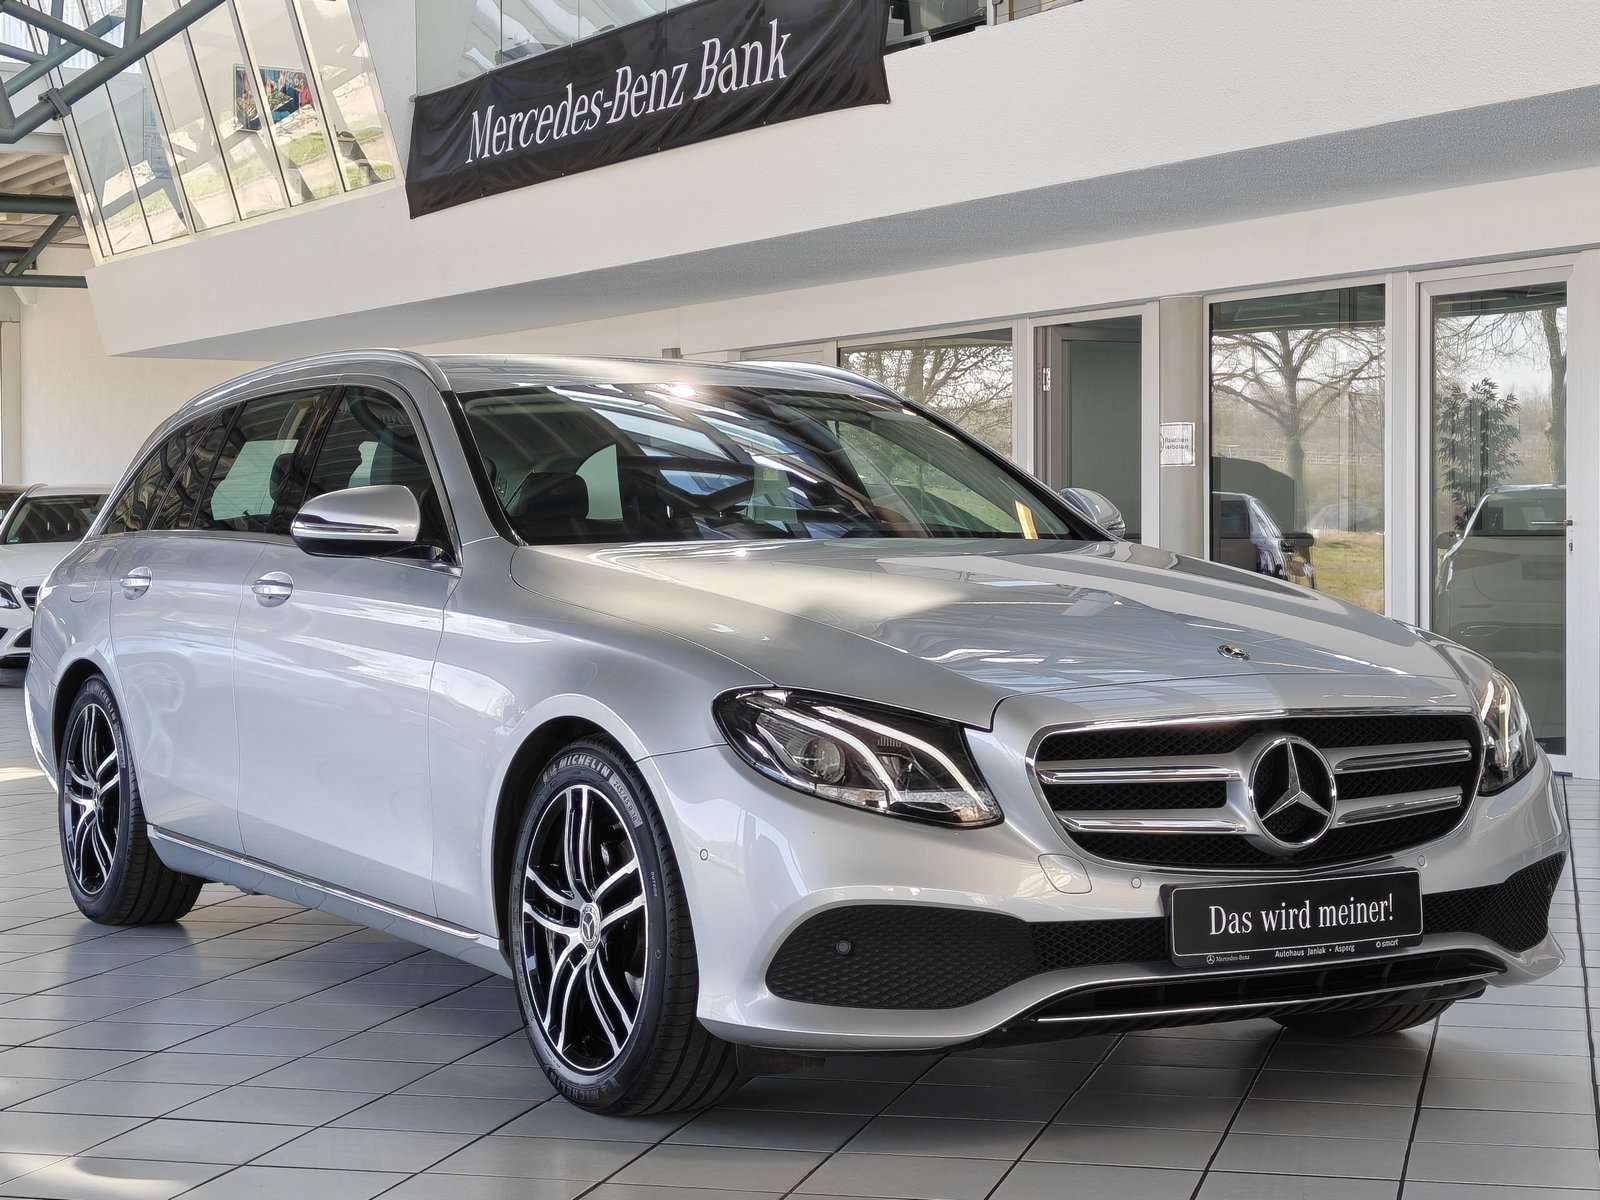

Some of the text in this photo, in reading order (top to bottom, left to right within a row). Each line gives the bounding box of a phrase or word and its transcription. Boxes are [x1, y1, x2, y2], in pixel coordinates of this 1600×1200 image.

[465, 18, 792, 164] Mercedes-Benz Bank
[558, 753, 612, 778] MICHELIN
[1209, 892, 1394, 936] Das wird meiner!
[1275, 949, 1305, 958] Autohaus
